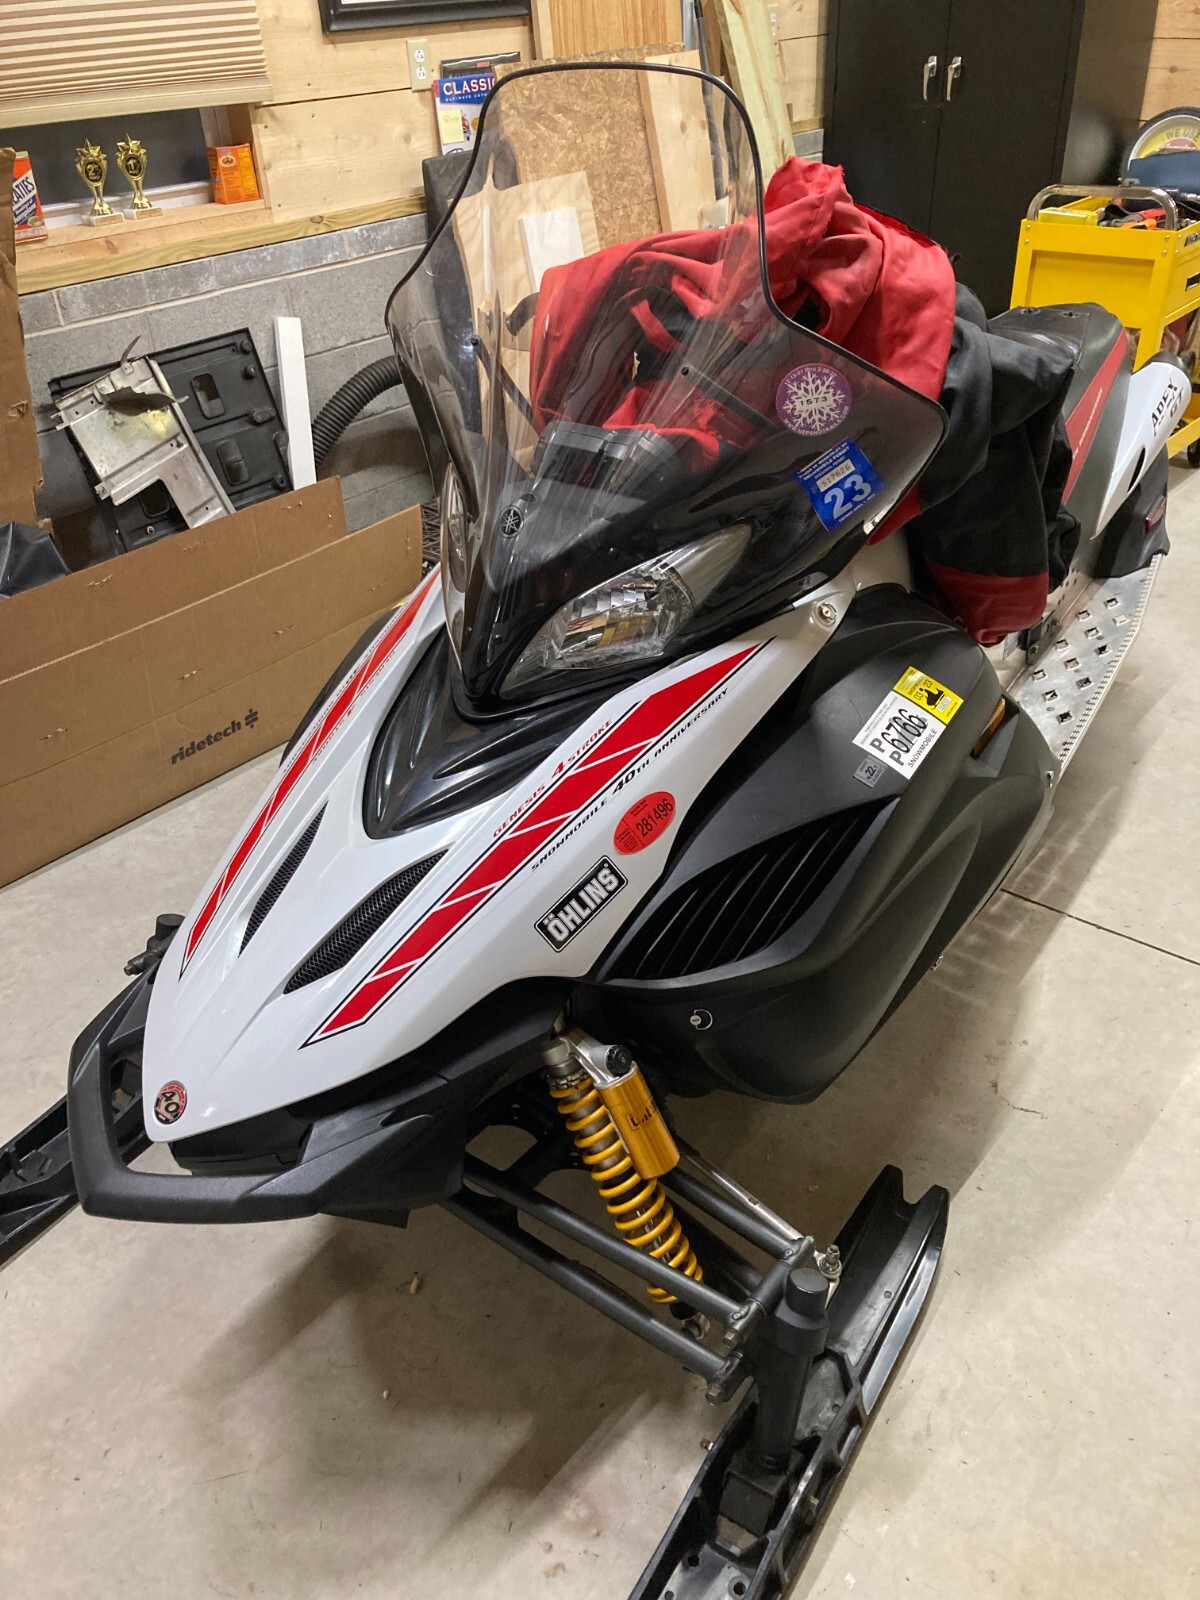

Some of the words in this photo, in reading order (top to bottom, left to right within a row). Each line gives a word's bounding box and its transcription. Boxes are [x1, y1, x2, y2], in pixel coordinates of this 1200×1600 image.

[800, 396, 828, 406] 1573
[803, 459, 833, 480] SNOWMOBILE
[832, 446, 850, 460] PERMIT
[821, 463, 851, 488] S17626
[824, 474, 872, 520] 23
[171, 720, 241, 765] ridetech
[551, 718, 613, 779] 4-STROKE
[869, 738, 885, 754] P
[881, 708, 928, 754] 6766
[908, 729, 938, 768] SNOWMOBILE
[865, 765, 877, 777] 22
[889, 750, 905, 767] P
[531, 796, 608, 872] SNOWMOBILE
[612, 759, 650, 795] 40TH
[654, 687, 728, 758] ANNIVERSARY
[493, 783, 546, 838] GENESIS
[636, 798, 674, 837] 281496
[542, 866, 619, 942] ÖHLINS
[161, 1091, 181, 1113] 40
